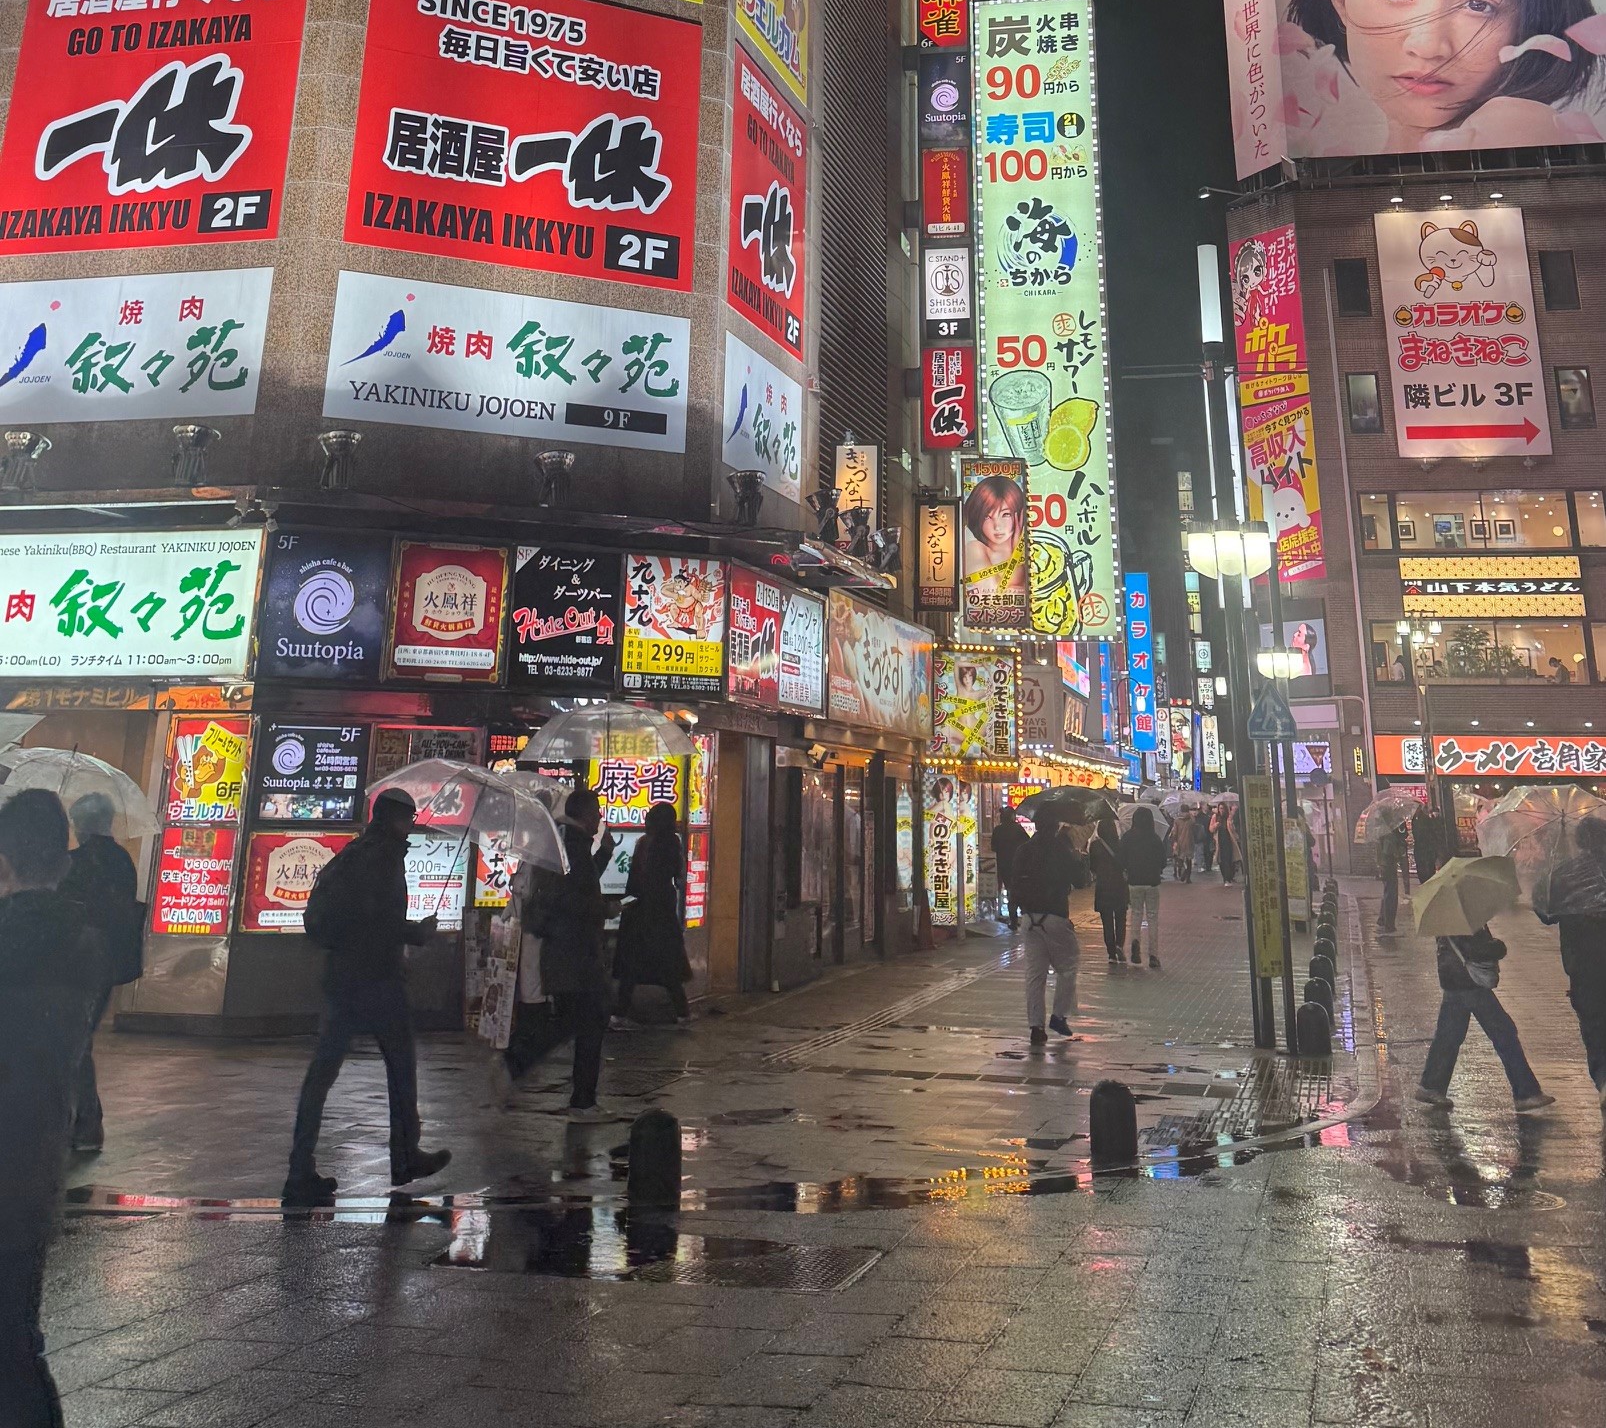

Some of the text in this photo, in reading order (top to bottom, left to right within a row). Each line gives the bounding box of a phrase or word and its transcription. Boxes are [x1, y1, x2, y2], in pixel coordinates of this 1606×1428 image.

[67, 13, 252, 57] GO TO IZAKAYA
[512, 5, 586, 45] 1975
[921, 38, 934, 49] 6F
[439, 25, 661, 101] 毎日旨くて安い店
[955, 55, 966, 63] 5F
[36, 54, 250, 194] 一休
[741, 62, 803, 158] 居酒屋行くなら
[925, 112, 966, 124] Suutopia
[986, 110, 1056, 146] 寿司
[769, 136, 795, 187] IZAKAYA
[108, 198, 192, 234] IKKYU
[210, 194, 261, 228] 2F
[362, 190, 595, 260] IZAKAYA IKKYU
[617, 233, 669, 271] 2F
[741, 180, 797, 300] 一休
[1267, 241, 1278, 316] ガールズバー
[1277, 236, 1288, 296] コンカフェ
[118, 295, 205, 326] 焼肉
[732, 264, 784, 333] IZAKAYA IKKYU
[929, 298, 967, 307] SHISHA
[1411, 300, 1507, 327] カラオケ
[786, 315, 800, 345] 2F
[938, 322, 958, 336] 3F
[64, 318, 249, 394] 叙々苑
[382, 350, 412, 360] JOJOEN
[426, 320, 681, 398] 焼肉 叙々苑
[1398, 331, 1532, 372] まねきねこ
[18, 375, 52, 384] JOJOEN
[349, 380, 557, 422] YAKINIKU JOJOEN
[1403, 382, 1534, 410] 隣ビル 3F
[1264, 406, 1310, 434] 今すぐ見つかる
[962, 439, 975, 448] 2F
[1248, 425, 1307, 471] 高収入
[972, 462, 1022, 476] 1500円
[1067, 470, 1106, 547] ハイボール
[24, 540, 257, 557] Yakiniku(BBQ) Restaurant YAKINIKU JOJOEN
[277, 534, 299, 551] 5F
[517, 548, 533, 561] 8F
[926, 506, 950, 582] きづなすし
[538, 554, 596, 573] ダイニング
[553, 583, 612, 602] ダーツバー
[571, 573, 582, 586] &
[626, 561, 657, 627] 九十九
[1426, 581, 1581, 594] 山下本気うどん
[49, 559, 246, 641] 叙々苑
[423, 591, 477, 611] 火鳳祥
[968, 594, 1026, 608] のぞき部屋
[968, 608, 1025, 624] マドンナ
[71, 654, 123, 667] ランチタイム
[276, 637, 364, 666] Suutopia
[1130, 590, 1154, 733] カラオケ館
[527, 664, 539, 675] TEL
[931, 657, 948, 752] マドンナ
[992, 669, 1010, 756] のぞき部屋
[340, 727, 362, 742] 5F
[215, 781, 241, 799] 6F
[262, 776, 311, 791] Suutopia
[594, 761, 678, 803] 麻雀
[168, 802, 239, 821] ウェルカム
[161, 871, 211, 882] 学生セット
[933, 822, 951, 910] のぞき部屋
[160, 908, 222, 923] WELCOME
